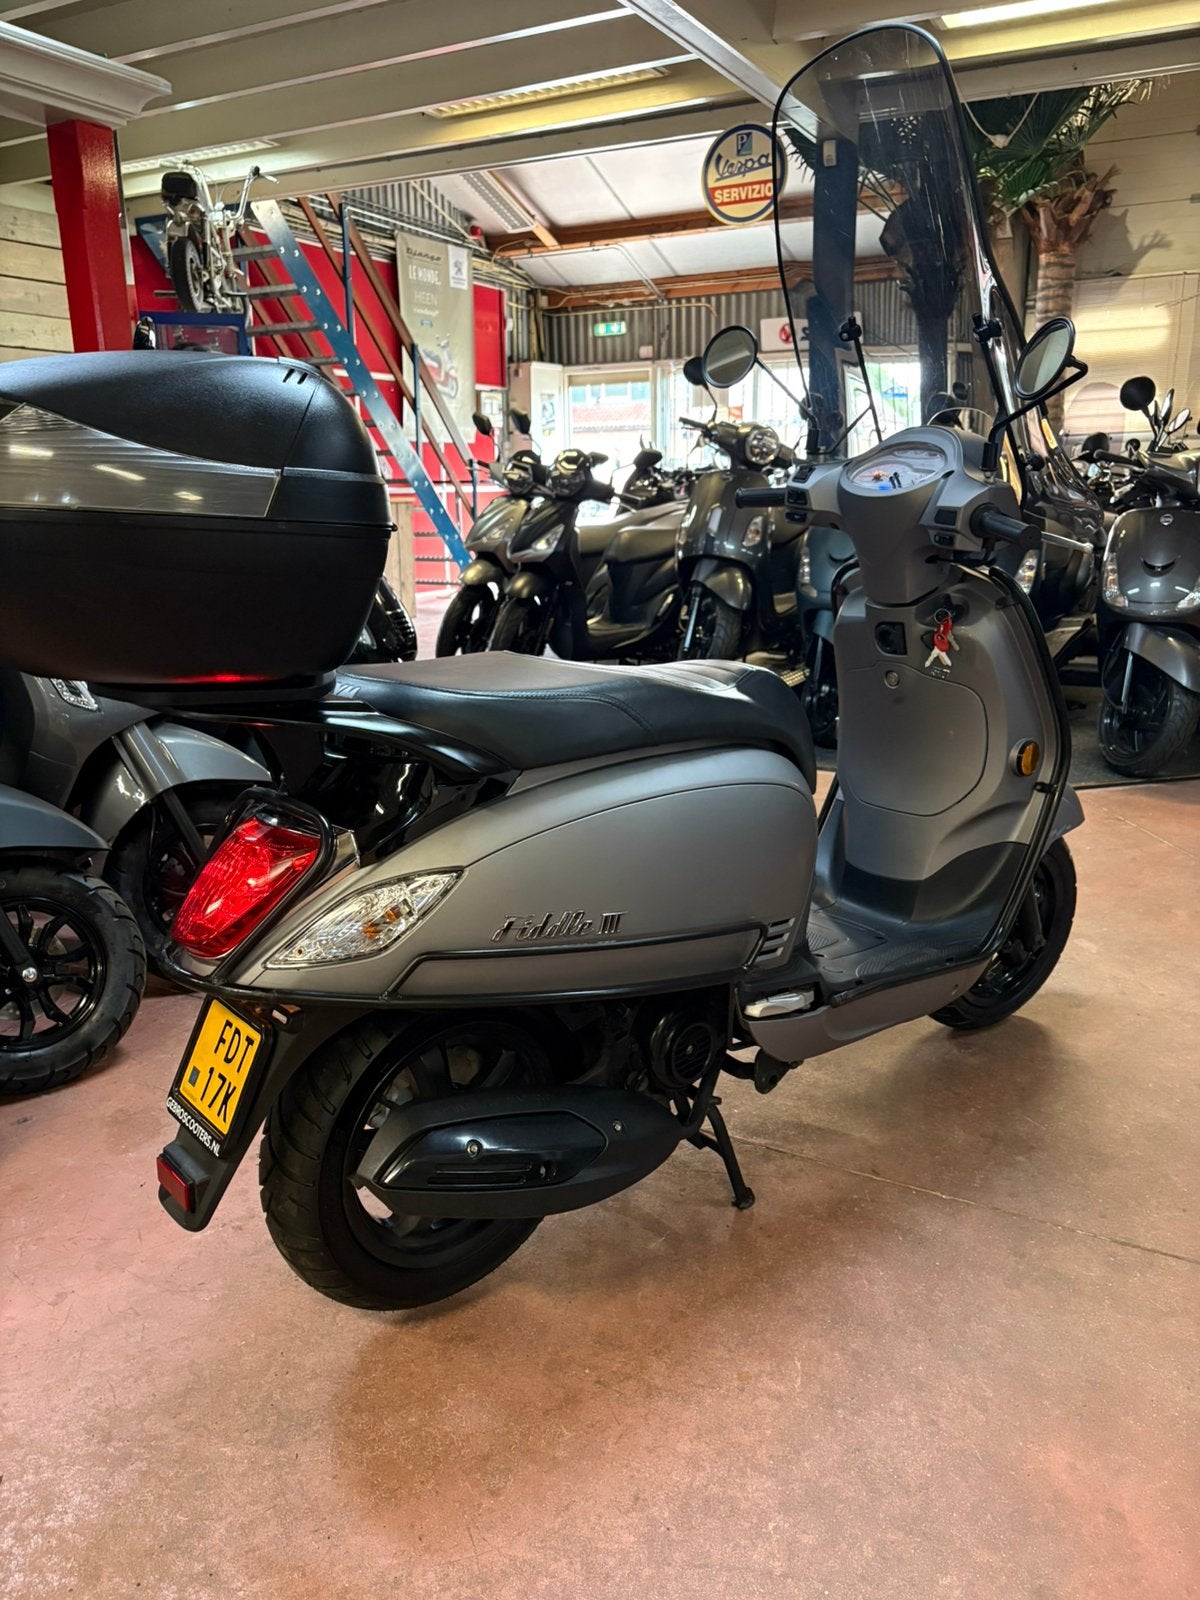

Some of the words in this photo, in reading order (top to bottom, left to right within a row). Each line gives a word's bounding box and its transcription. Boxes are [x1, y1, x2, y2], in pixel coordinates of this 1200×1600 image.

[714, 152, 772, 183] Vespa
[714, 182, 774, 204] SERVIZIO
[490, 909, 594, 943] Fiddle
[214, 1019, 255, 1073] FDT
[200, 1067, 237, 1123] 17K
[165, 1096, 221, 1158] GEBROSCOOTERS.NL
